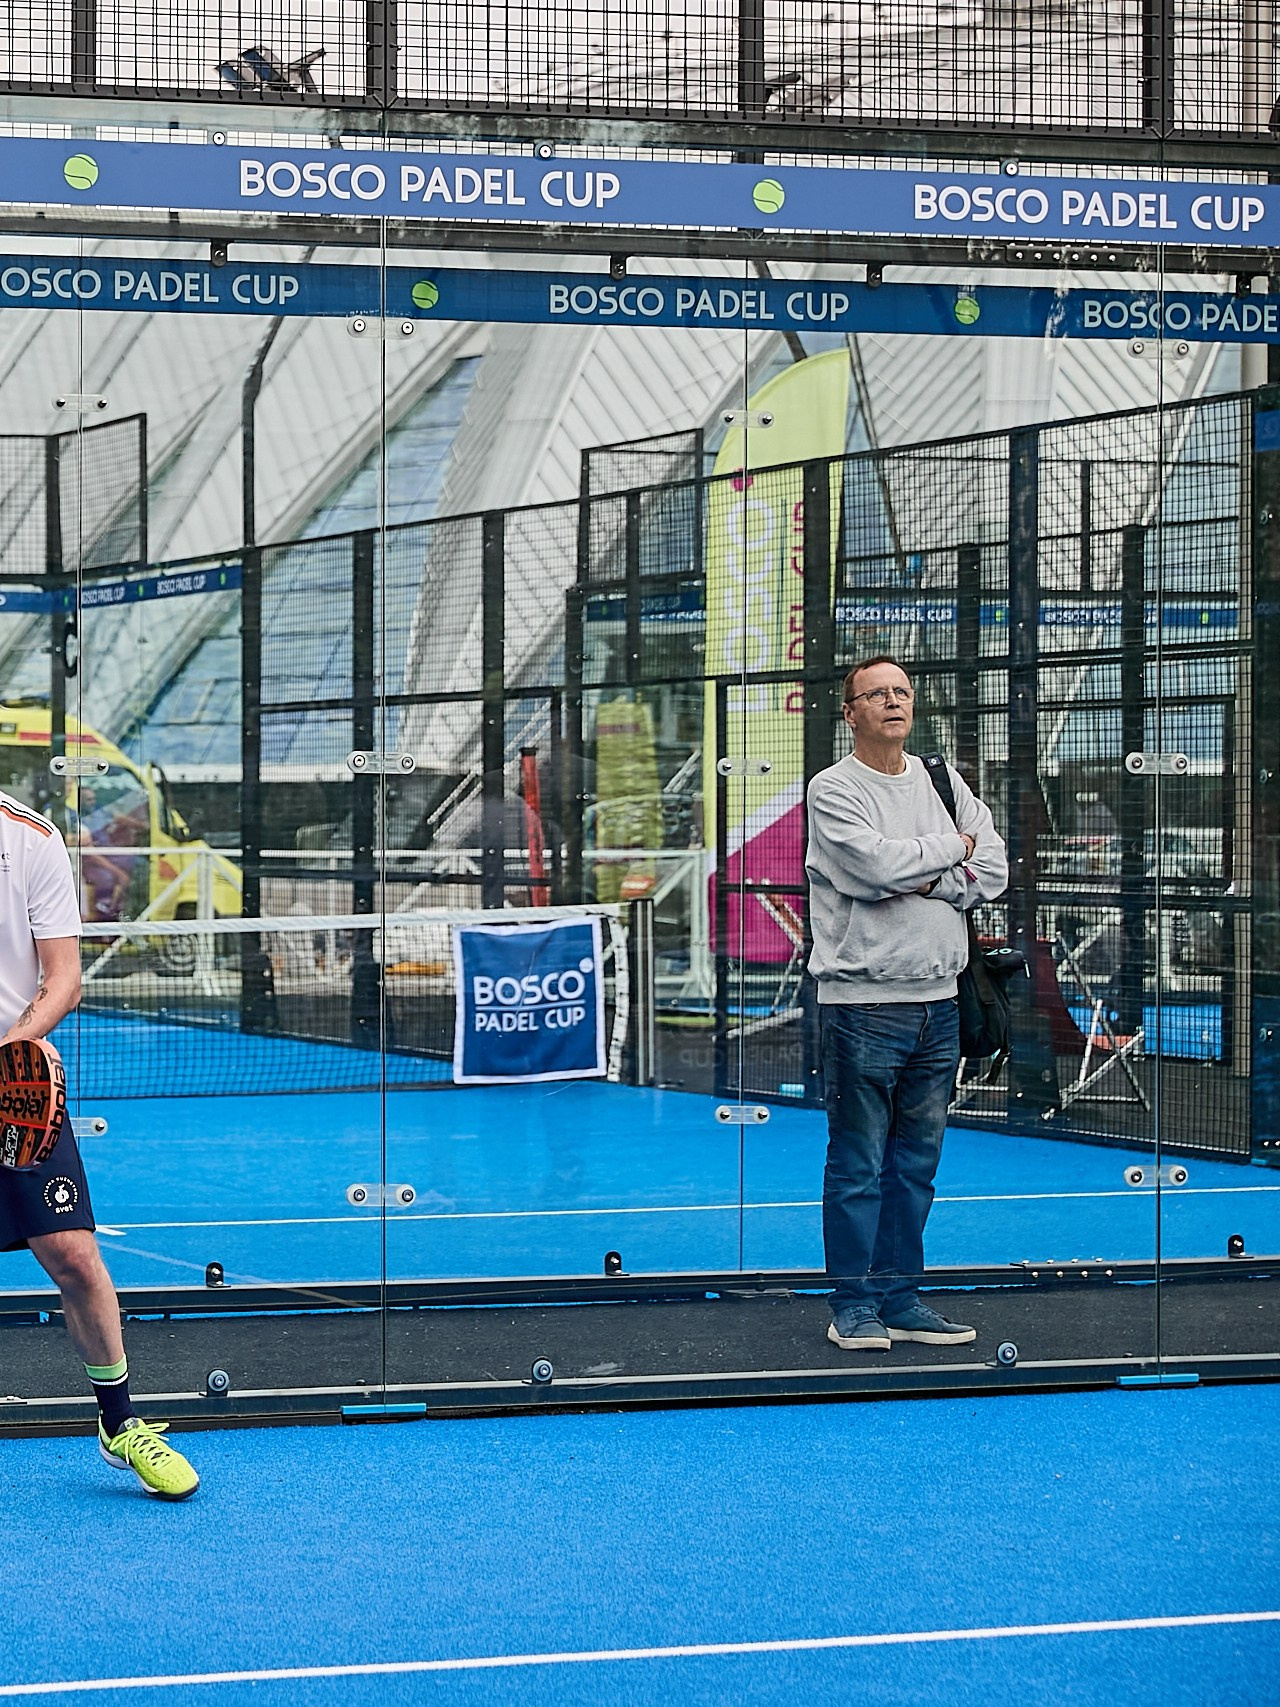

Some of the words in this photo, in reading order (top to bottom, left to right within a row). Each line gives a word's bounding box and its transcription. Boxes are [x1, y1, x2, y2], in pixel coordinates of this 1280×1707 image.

[240, 160, 386, 201] BOSCO
[400, 165, 526, 206] PADEL
[540, 170, 621, 208] CUP
[914, 184, 1049, 223] BOSCO
[1062, 190, 1177, 229] PADEL
[1190, 195, 1265, 231] CUP
[113, 270, 219, 304] PADEL
[231, 275, 299, 305] CUP
[549, 284, 665, 316] BOSCO
[676, 288, 774, 320] PADEL
[786, 292, 850, 322] CUP
[1083, 300, 1191, 331] BOSCO
[1201, 303, 1279, 333] PADE
[927, 607, 953, 622] CUP
[473, 970, 586, 1006] BOSCO
[475, 1012, 539, 1032] PADEL
[544, 1007, 586, 1029] CUP
